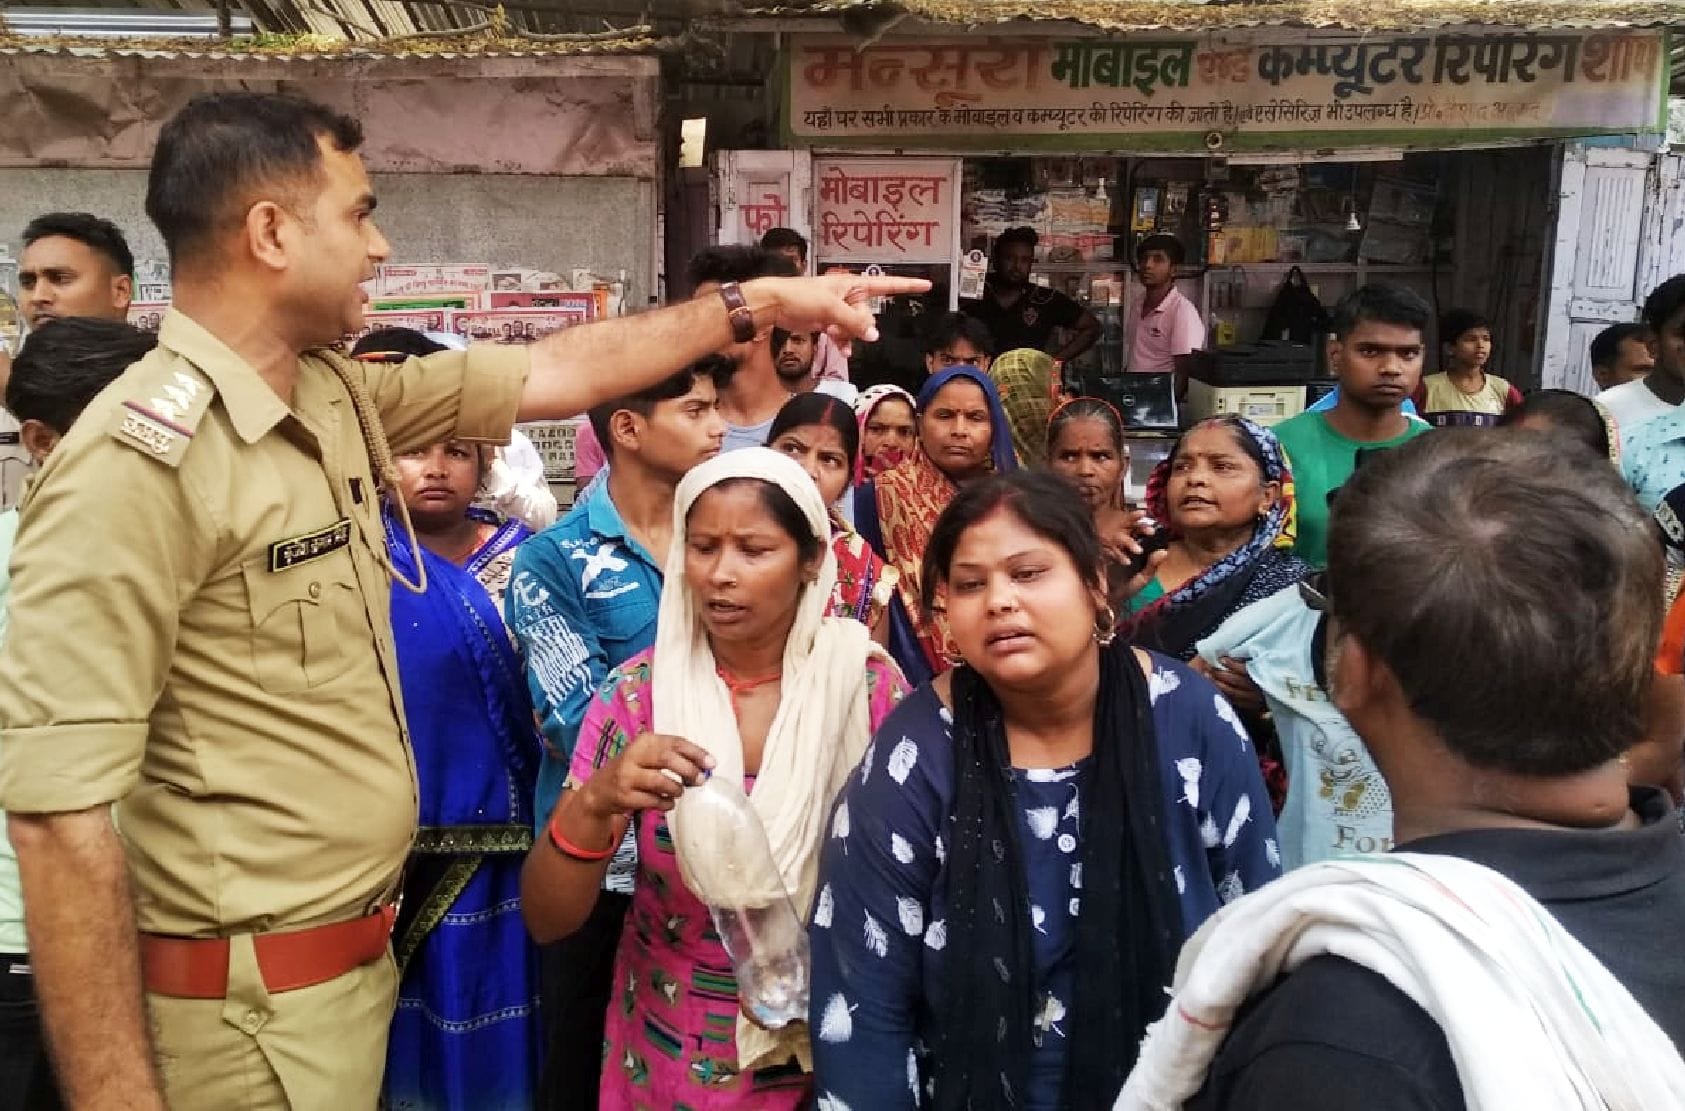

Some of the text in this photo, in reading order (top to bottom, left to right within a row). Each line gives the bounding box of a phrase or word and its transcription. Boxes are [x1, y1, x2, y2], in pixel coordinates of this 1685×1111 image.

[834, 110, 859, 128] पर
[861, 104, 895, 128] सभी
[897, 109, 936, 128] प्रकार
[1089, 102, 1106, 123] की
[1165, 101, 1185, 123] की
[1327, 99, 1346, 121] भी
[820, 167, 947, 211] मोबाइल
[821, 210, 940, 252] रिपेरिंग
